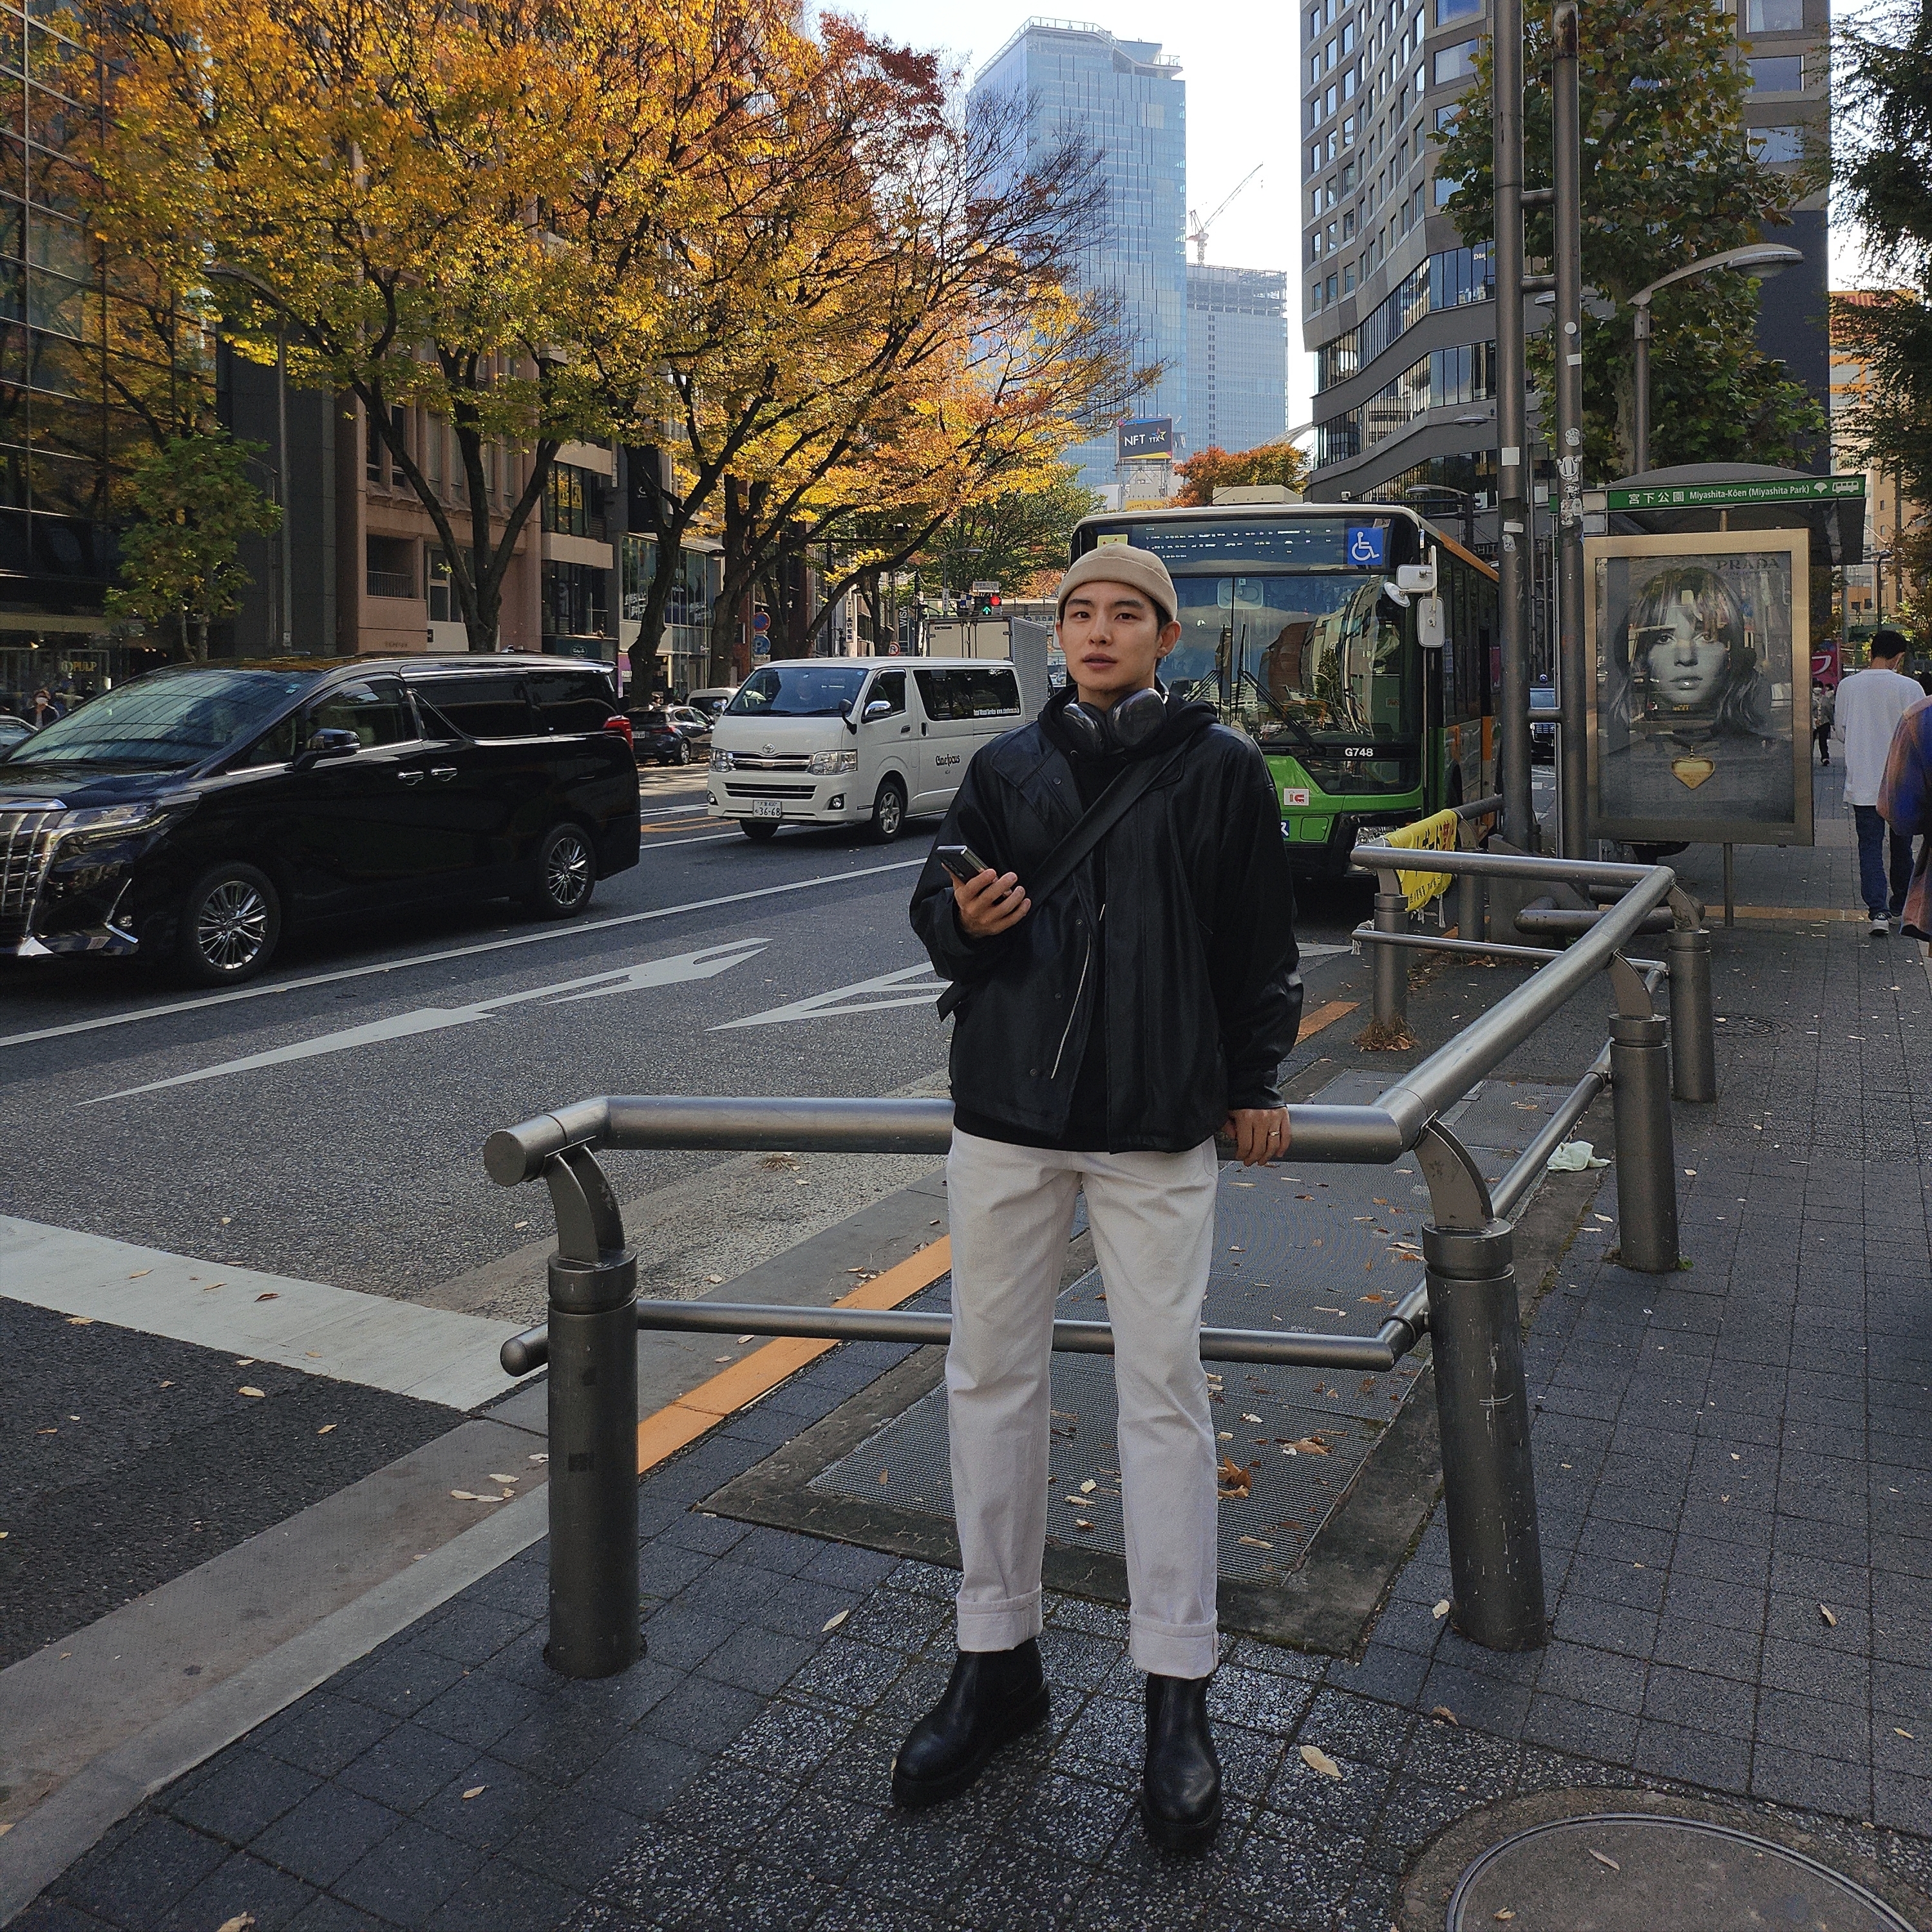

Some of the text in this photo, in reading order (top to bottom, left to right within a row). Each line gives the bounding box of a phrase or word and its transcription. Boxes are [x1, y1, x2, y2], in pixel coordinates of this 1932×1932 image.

[1124, 434, 1146, 447] NFT
[1628, 491, 1685, 505] 宮下公園
[1748, 486, 1788, 498] (Miyashita
[1790, 484, 1810, 495] Park)
[1345, 748, 1374, 757] G748
[759, 807, 781, 816] 36-68
